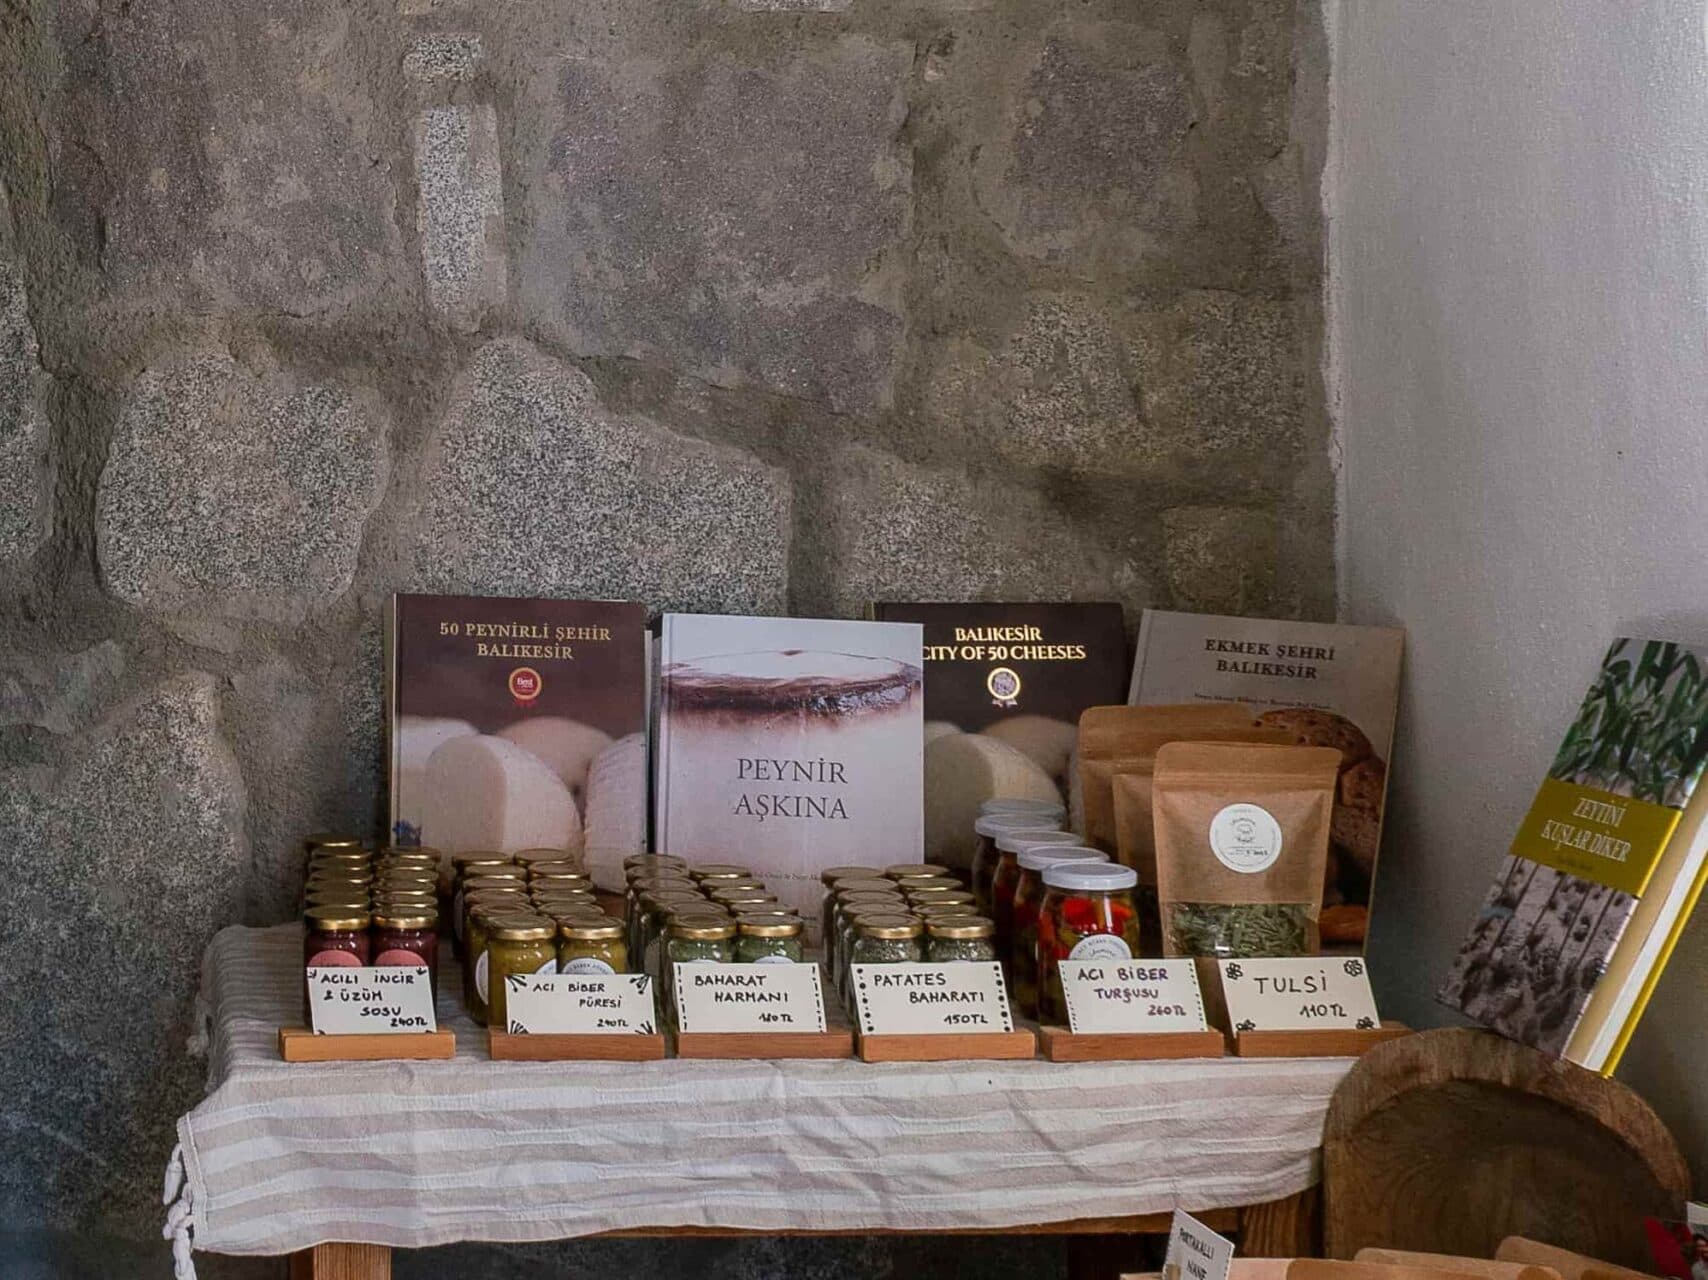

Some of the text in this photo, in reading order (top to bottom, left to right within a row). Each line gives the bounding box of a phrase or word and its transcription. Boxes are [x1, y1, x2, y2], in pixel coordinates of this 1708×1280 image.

[439, 622, 611, 641] 50 PEYNİRLİ ŞEHİR
[955, 625, 1043, 641] BALIKESİR
[477, 643, 573, 660] BALIKESİR
[961, 646, 987, 660] OF
[988, 646, 1007, 661] 50
[1010, 645, 1087, 660] CHEESES
[1205, 639, 1336, 661] EKMEK ŞEHRİ
[1216, 659, 1317, 679] BALIKESİR
[736, 757, 848, 784] PEYNİR
[733, 793, 849, 822] AŞKINA
[321, 970, 415, 984] ACILI İNCİR
[694, 975, 766, 986] BAHARAT
[874, 973, 946, 986] PATATES
[1077, 966, 1168, 981] ACI BİBER
[533, 981, 605, 993] ACI BİBER
[1254, 970, 1327, 994] TULSİ
[579, 995, 622, 1008] PÜRESİ
[714, 991, 788, 1003] HARMANI
[909, 991, 985, 1004] BAHARATI
[1094, 988, 1159, 1003] TURŞUSU
[360, 1007, 401, 1016] SOSU
